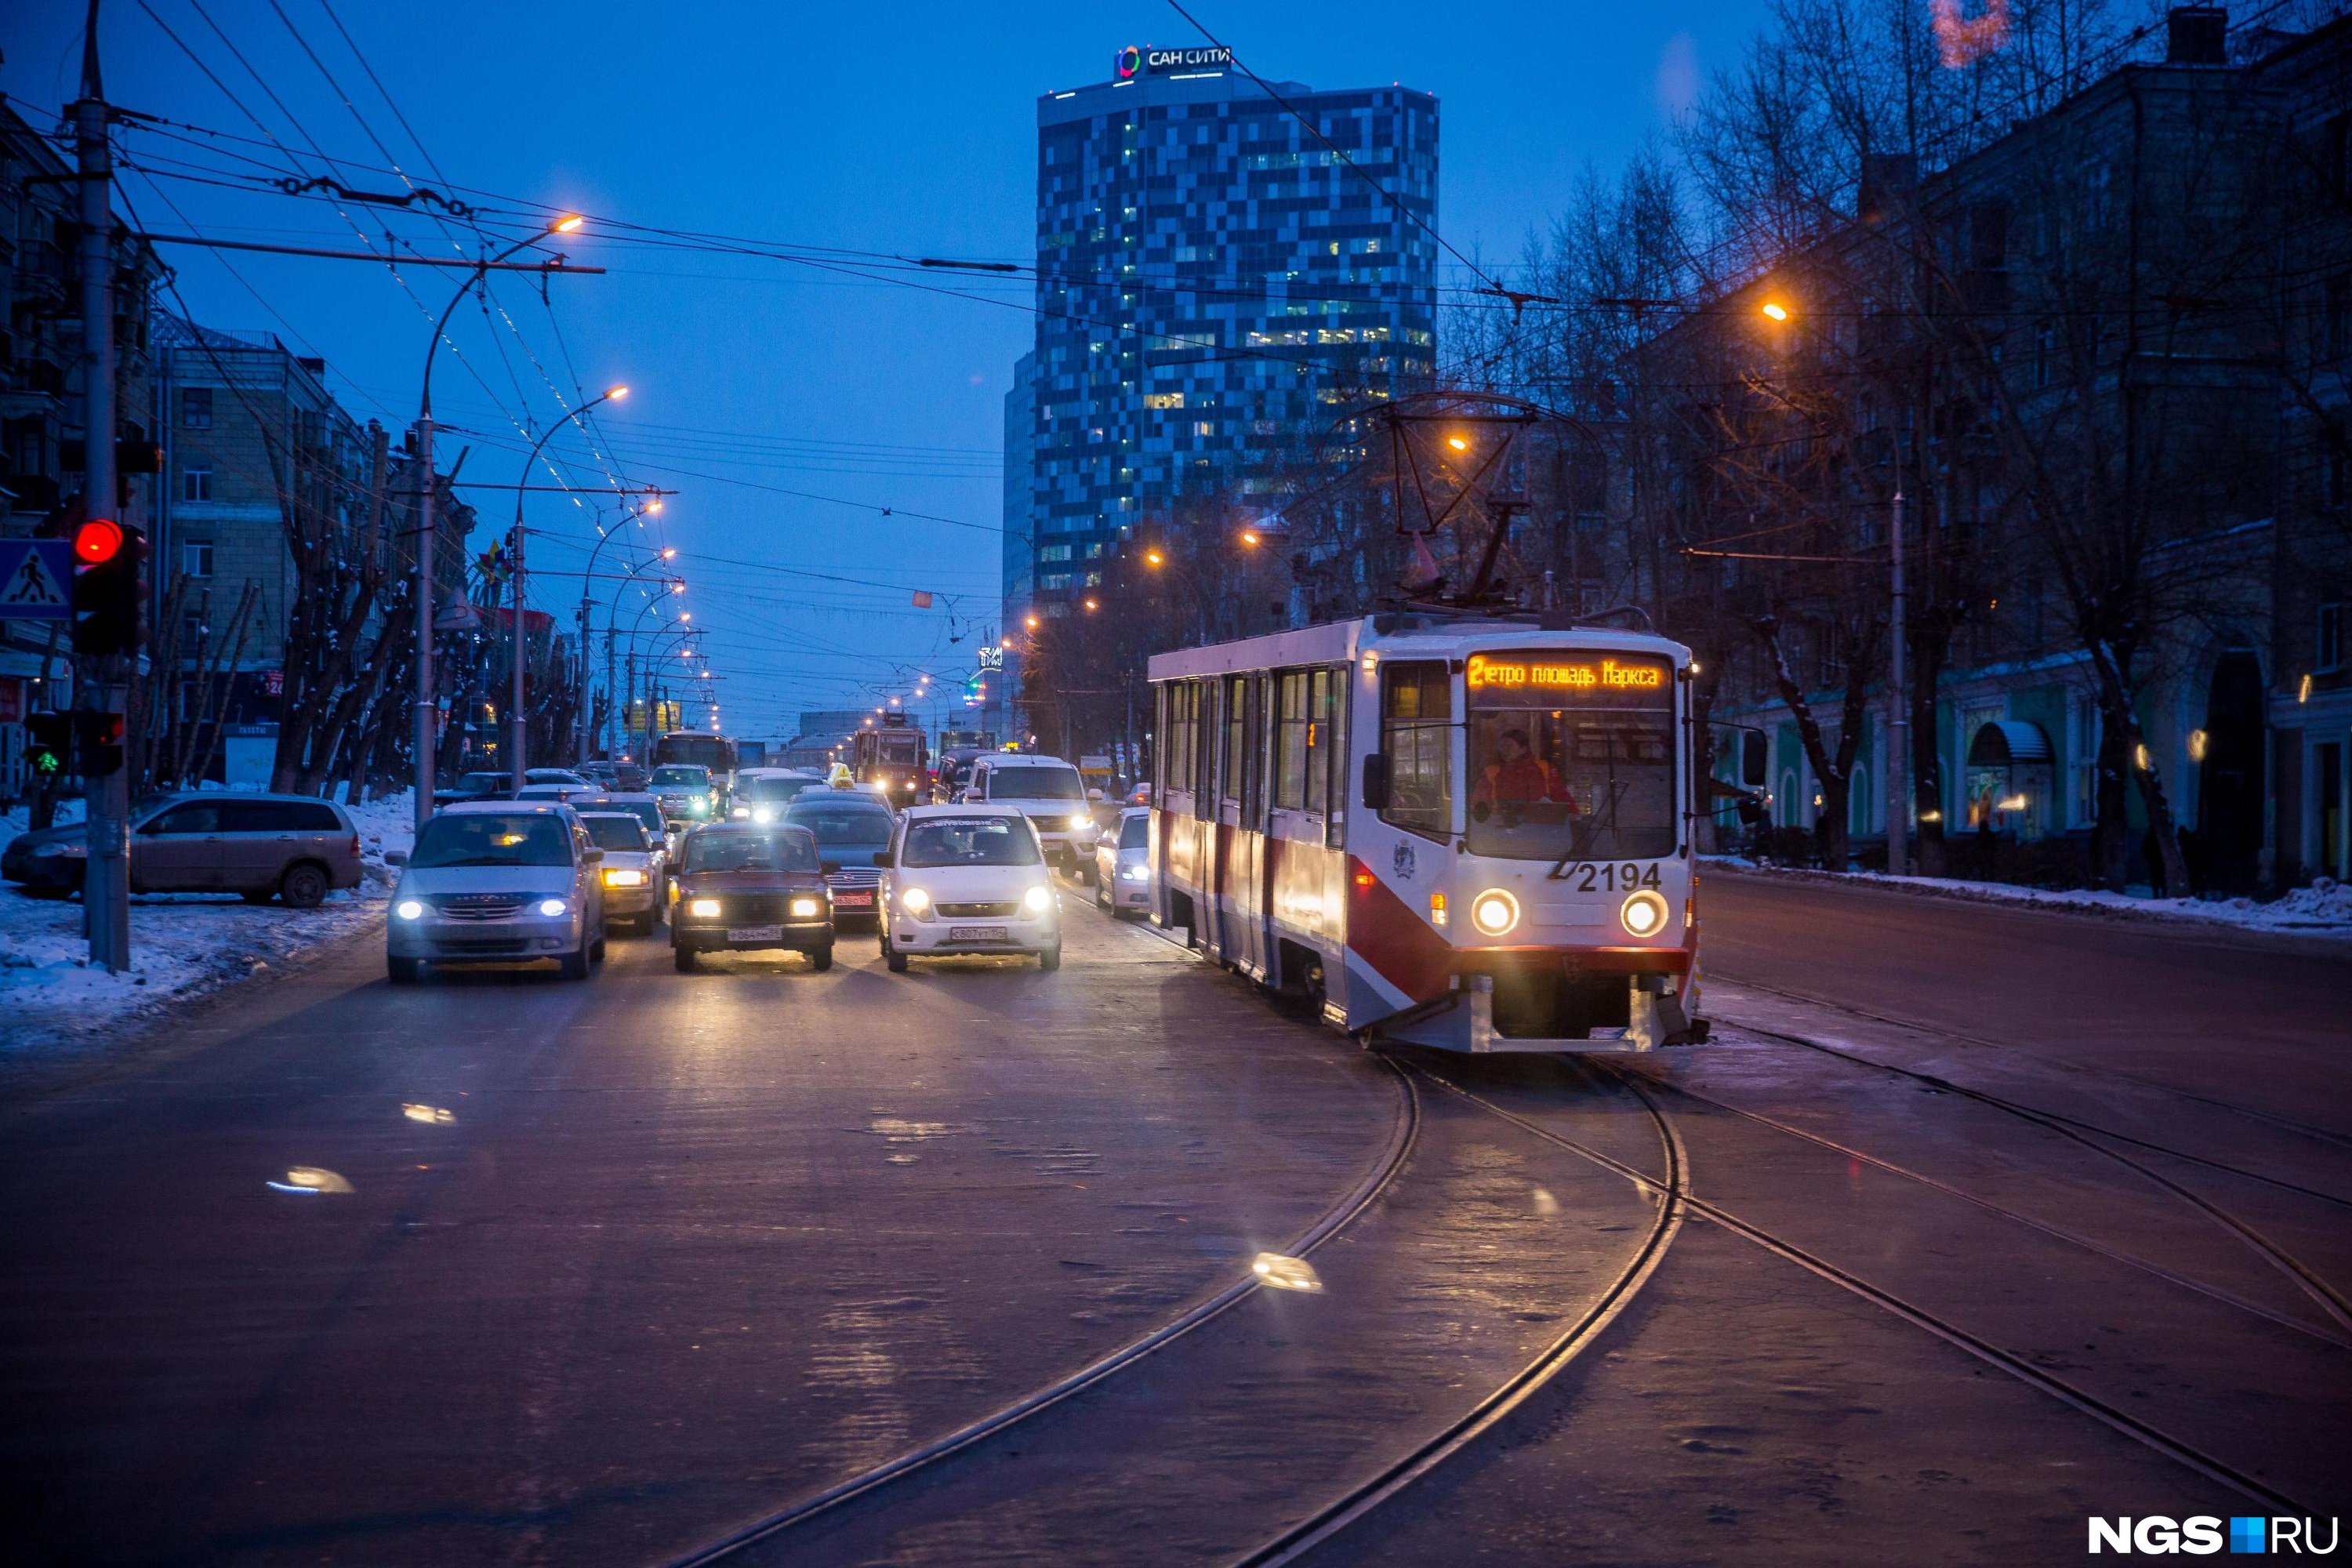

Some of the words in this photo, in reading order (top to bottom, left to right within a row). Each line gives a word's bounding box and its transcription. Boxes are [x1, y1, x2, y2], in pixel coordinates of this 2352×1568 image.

[1149, 51, 1181, 66] САН
[1186, 48, 1230, 64] СИТИ
[1468, 658, 1483, 684] 2
[1532, 667, 1595, 686] площадь
[1602, 662, 1658, 687] Маркса
[1577, 862, 1661, 891] 2194
